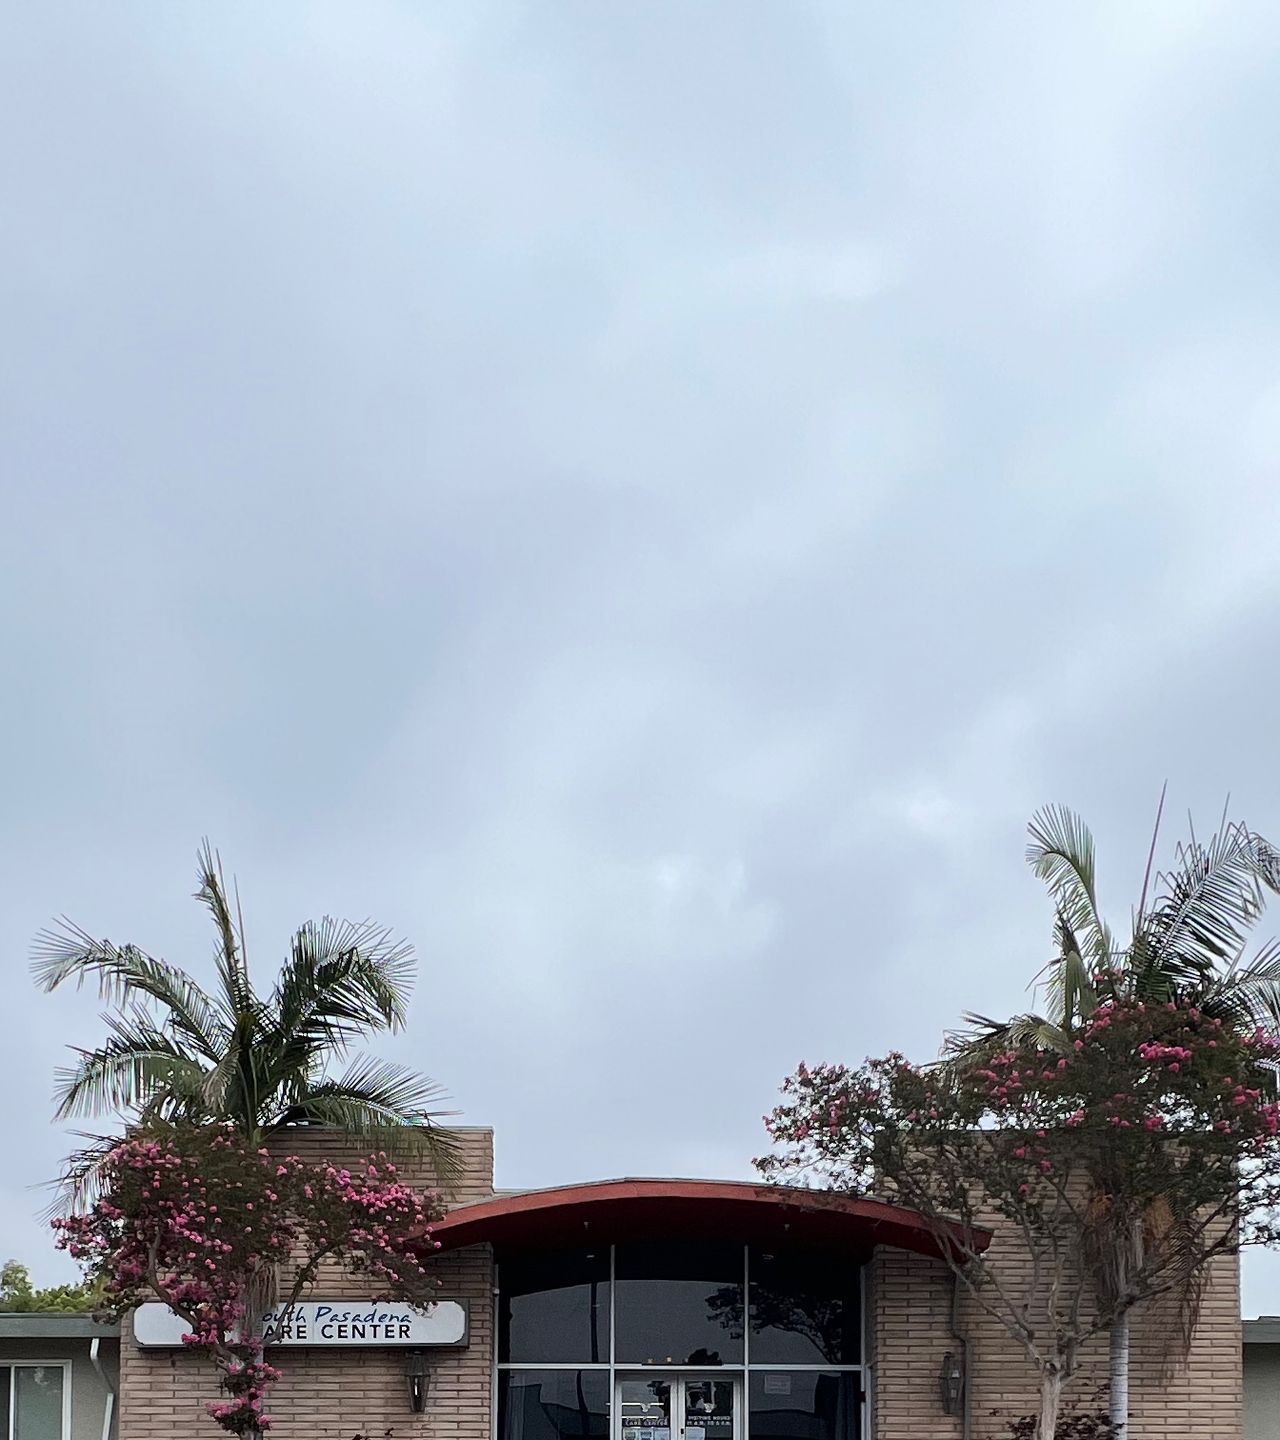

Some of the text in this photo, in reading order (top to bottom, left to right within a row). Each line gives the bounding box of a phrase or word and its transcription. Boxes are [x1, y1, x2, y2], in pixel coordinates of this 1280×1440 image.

[261, 1306, 412, 1323] outh Pasadena
[262, 1324, 411, 1340] ARE CENTER
